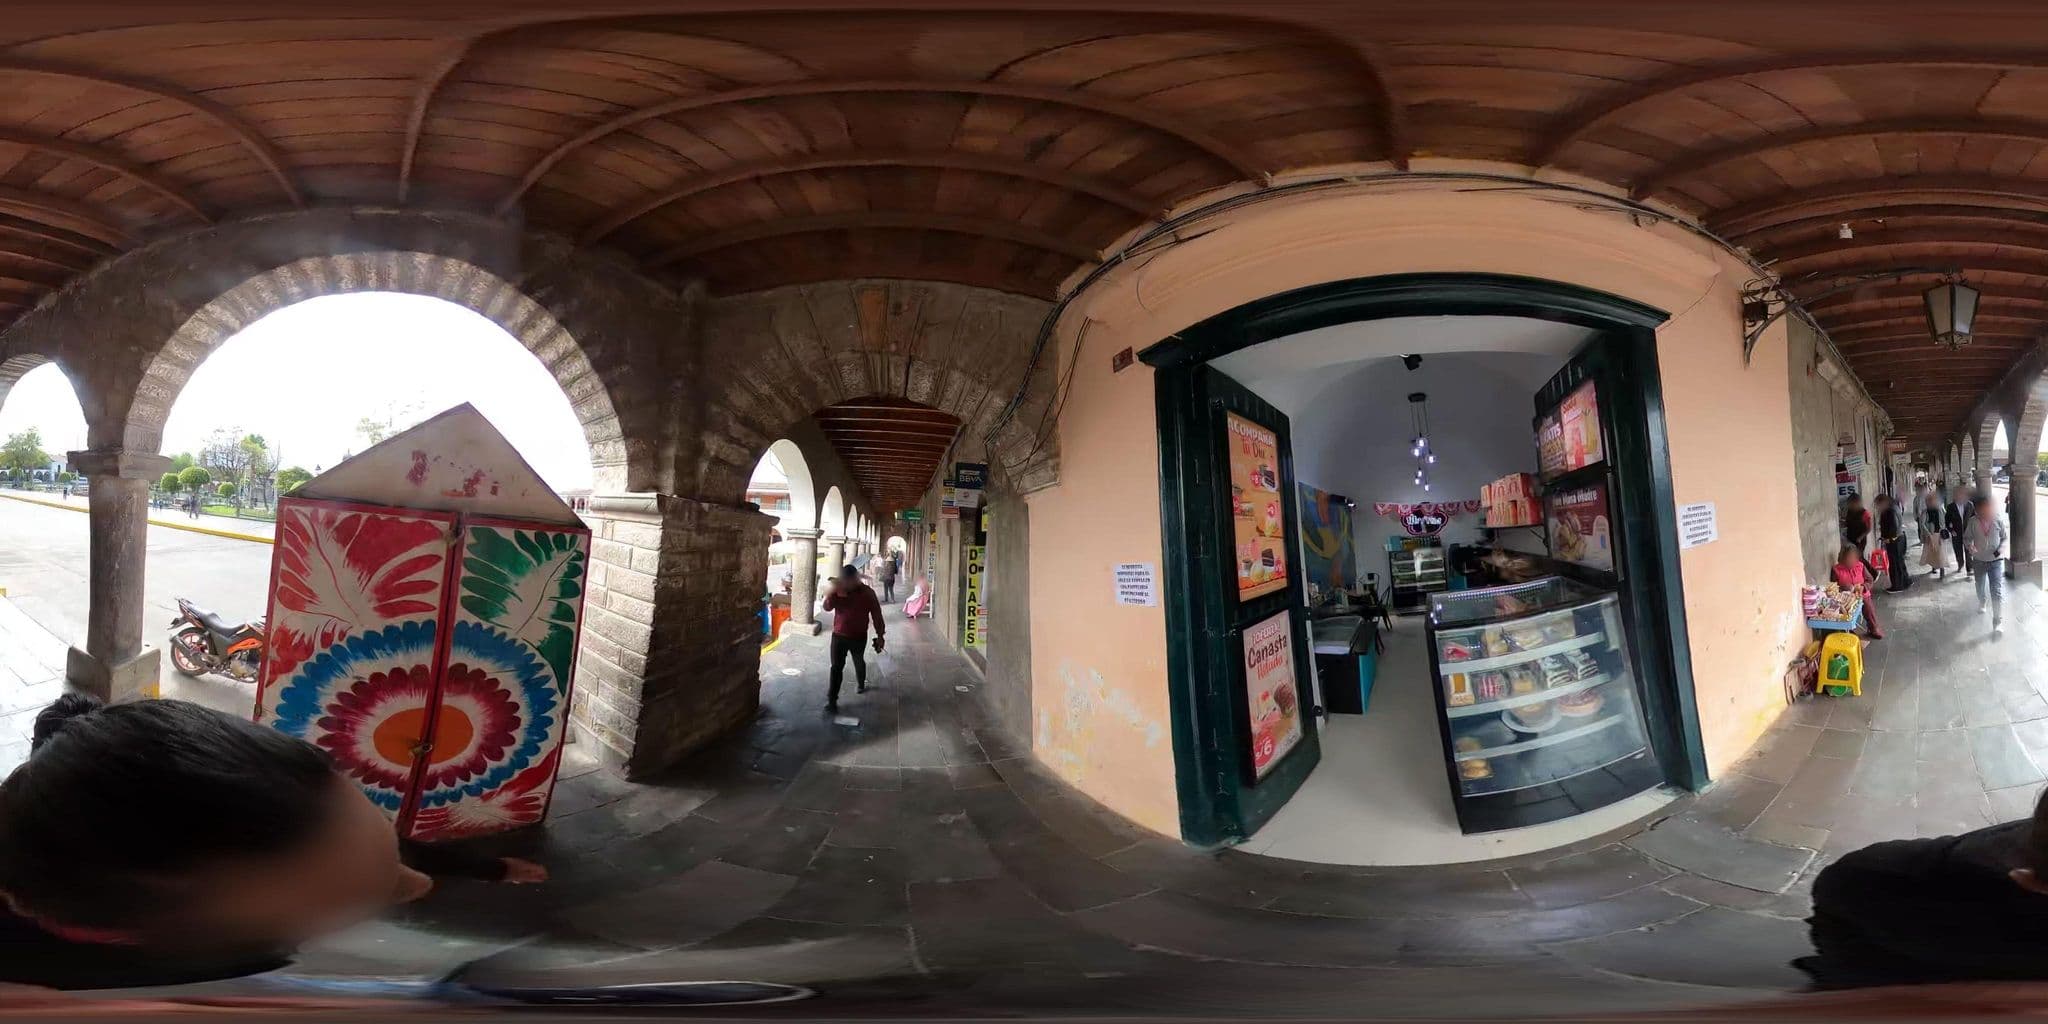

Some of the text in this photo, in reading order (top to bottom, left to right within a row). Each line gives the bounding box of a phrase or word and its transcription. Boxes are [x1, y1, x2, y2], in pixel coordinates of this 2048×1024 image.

[960, 474, 982, 482] BBVA
[967, 549, 978, 645] DOLARES
[1248, 634, 1288, 669] Canasta
